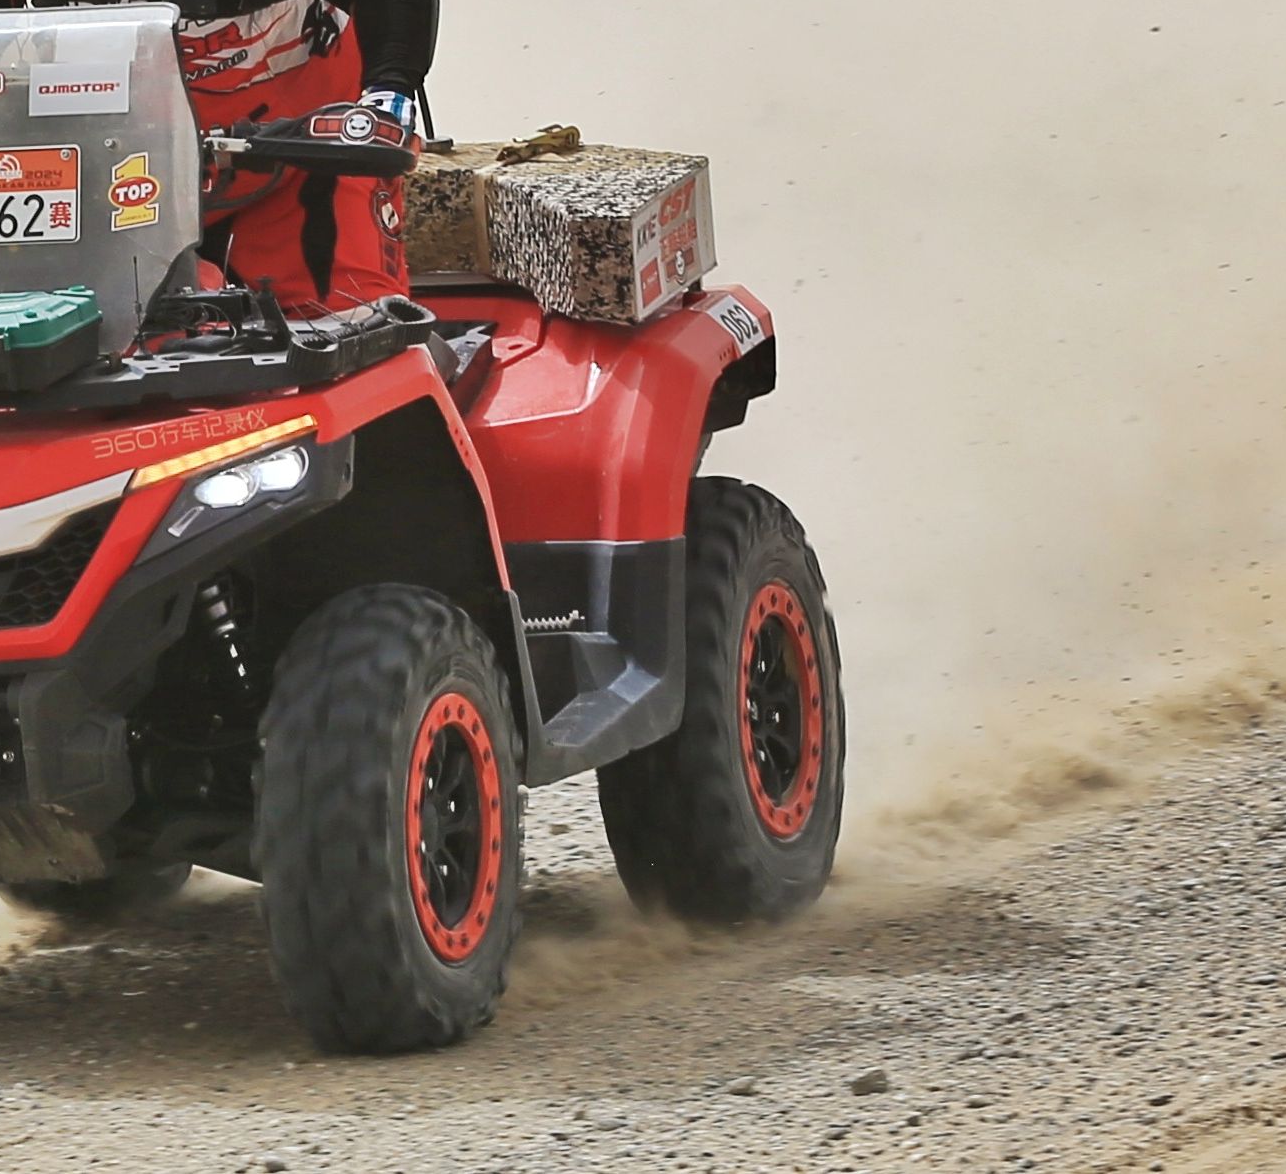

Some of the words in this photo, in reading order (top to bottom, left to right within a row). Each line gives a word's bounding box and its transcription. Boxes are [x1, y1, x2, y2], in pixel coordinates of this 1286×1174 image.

[25, 169, 63, 179] 2024
[27, 180, 62, 188] RALLY
[115, 182, 154, 203] TOP
[49, 200, 72, 229] 赛
[719, 304, 760, 345] 062
[91, 408, 269, 460] 360行车记录仪
